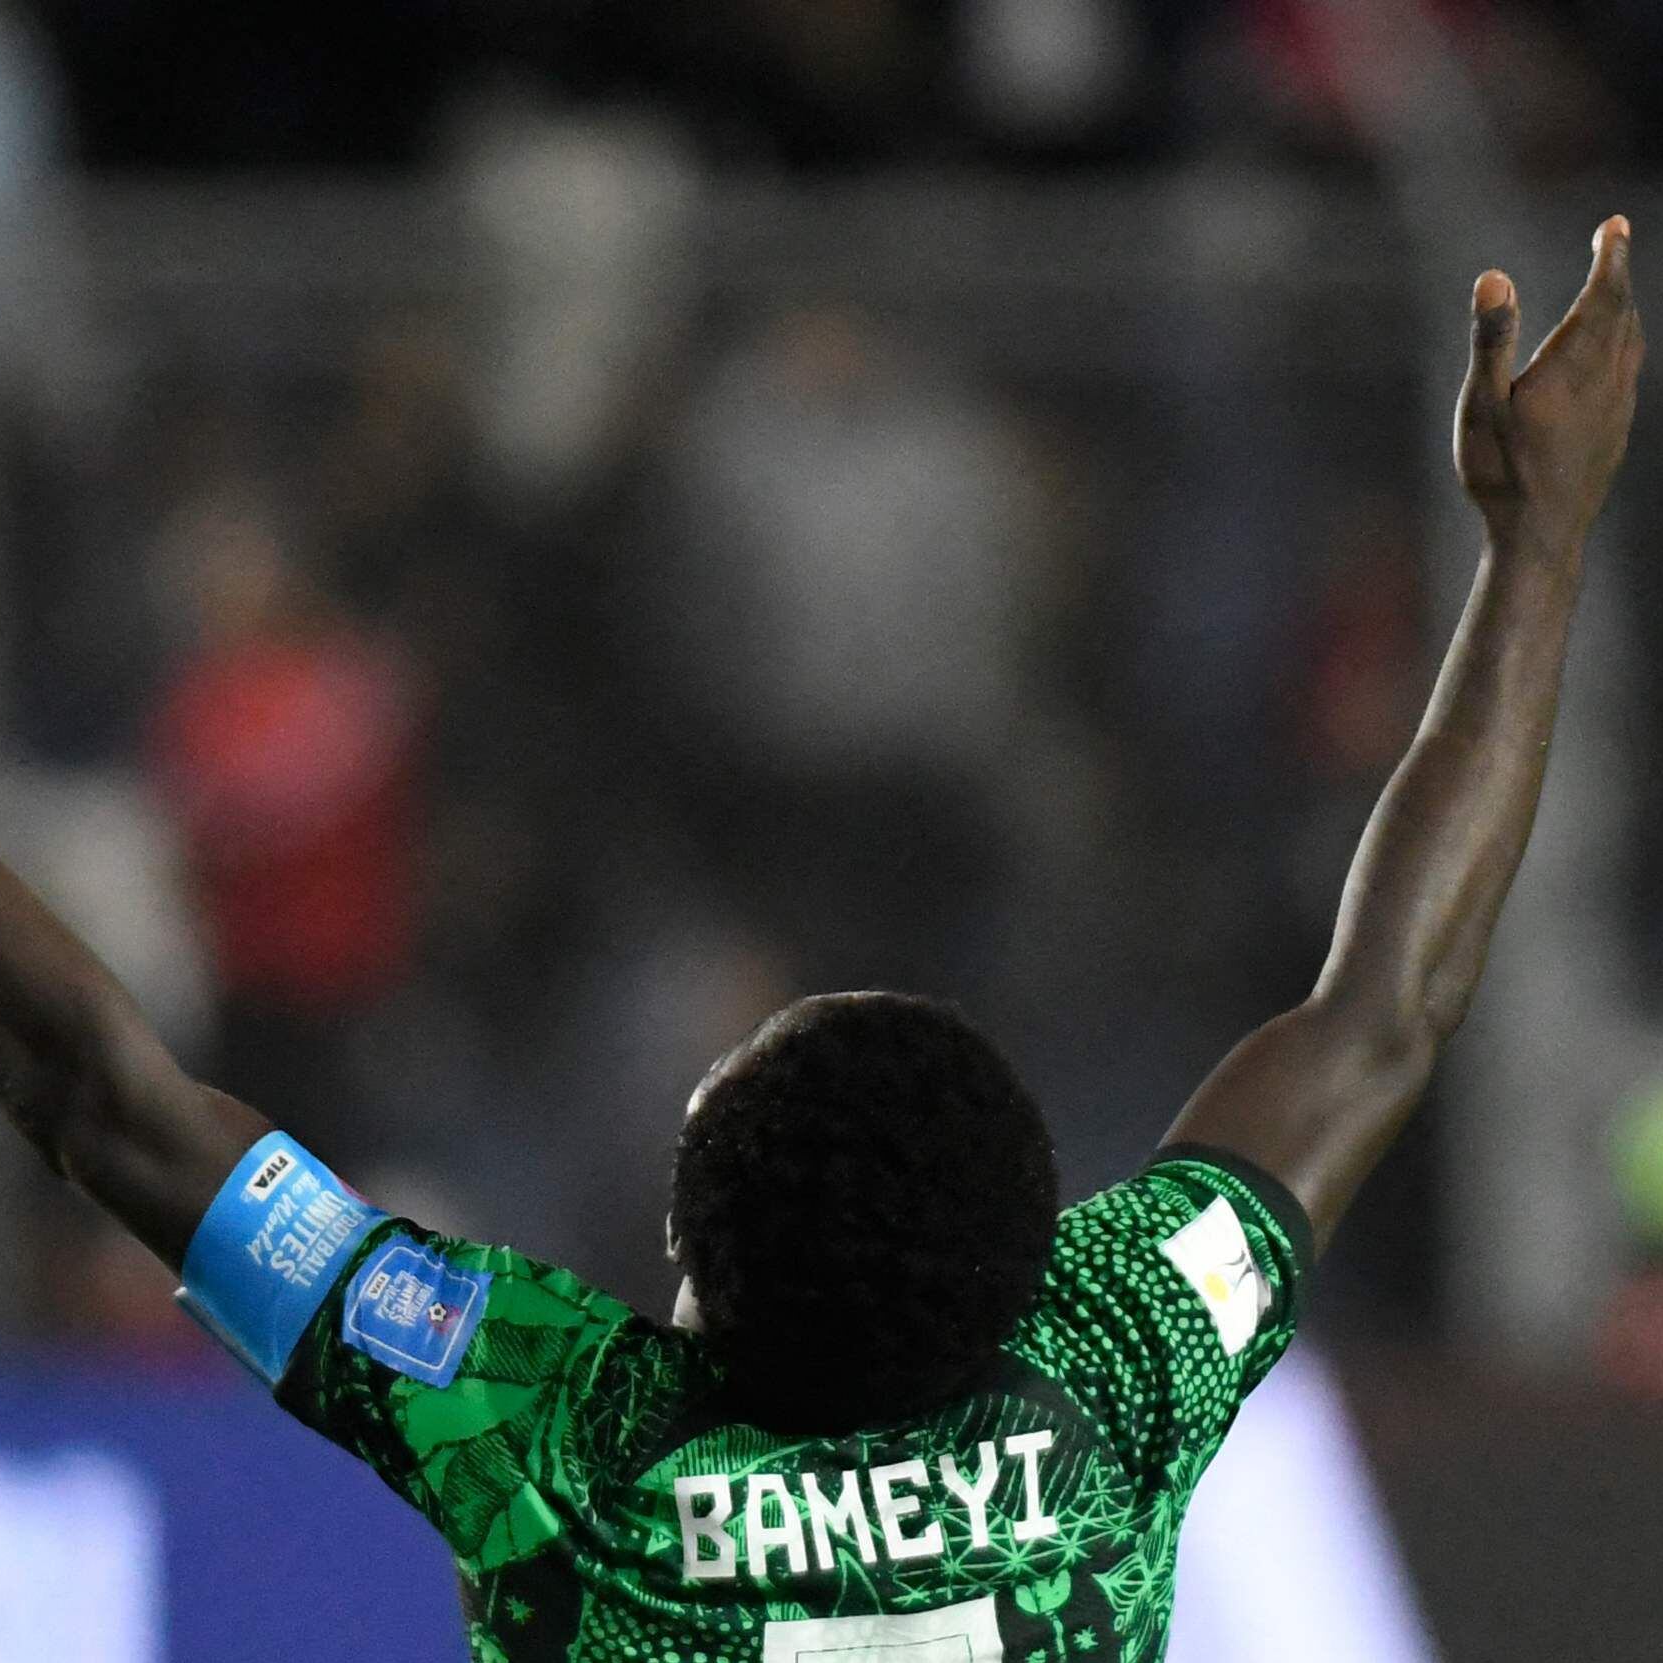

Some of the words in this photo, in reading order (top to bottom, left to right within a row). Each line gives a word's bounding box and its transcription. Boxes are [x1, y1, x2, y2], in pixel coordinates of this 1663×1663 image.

[254, 1155, 289, 1189] FIFA
[246, 1193, 300, 1265] World
[269, 1190, 349, 1279] UNITES
[291, 1205, 366, 1287] FOOTBALL
[673, 1430, 1058, 1580] BAMEYI
